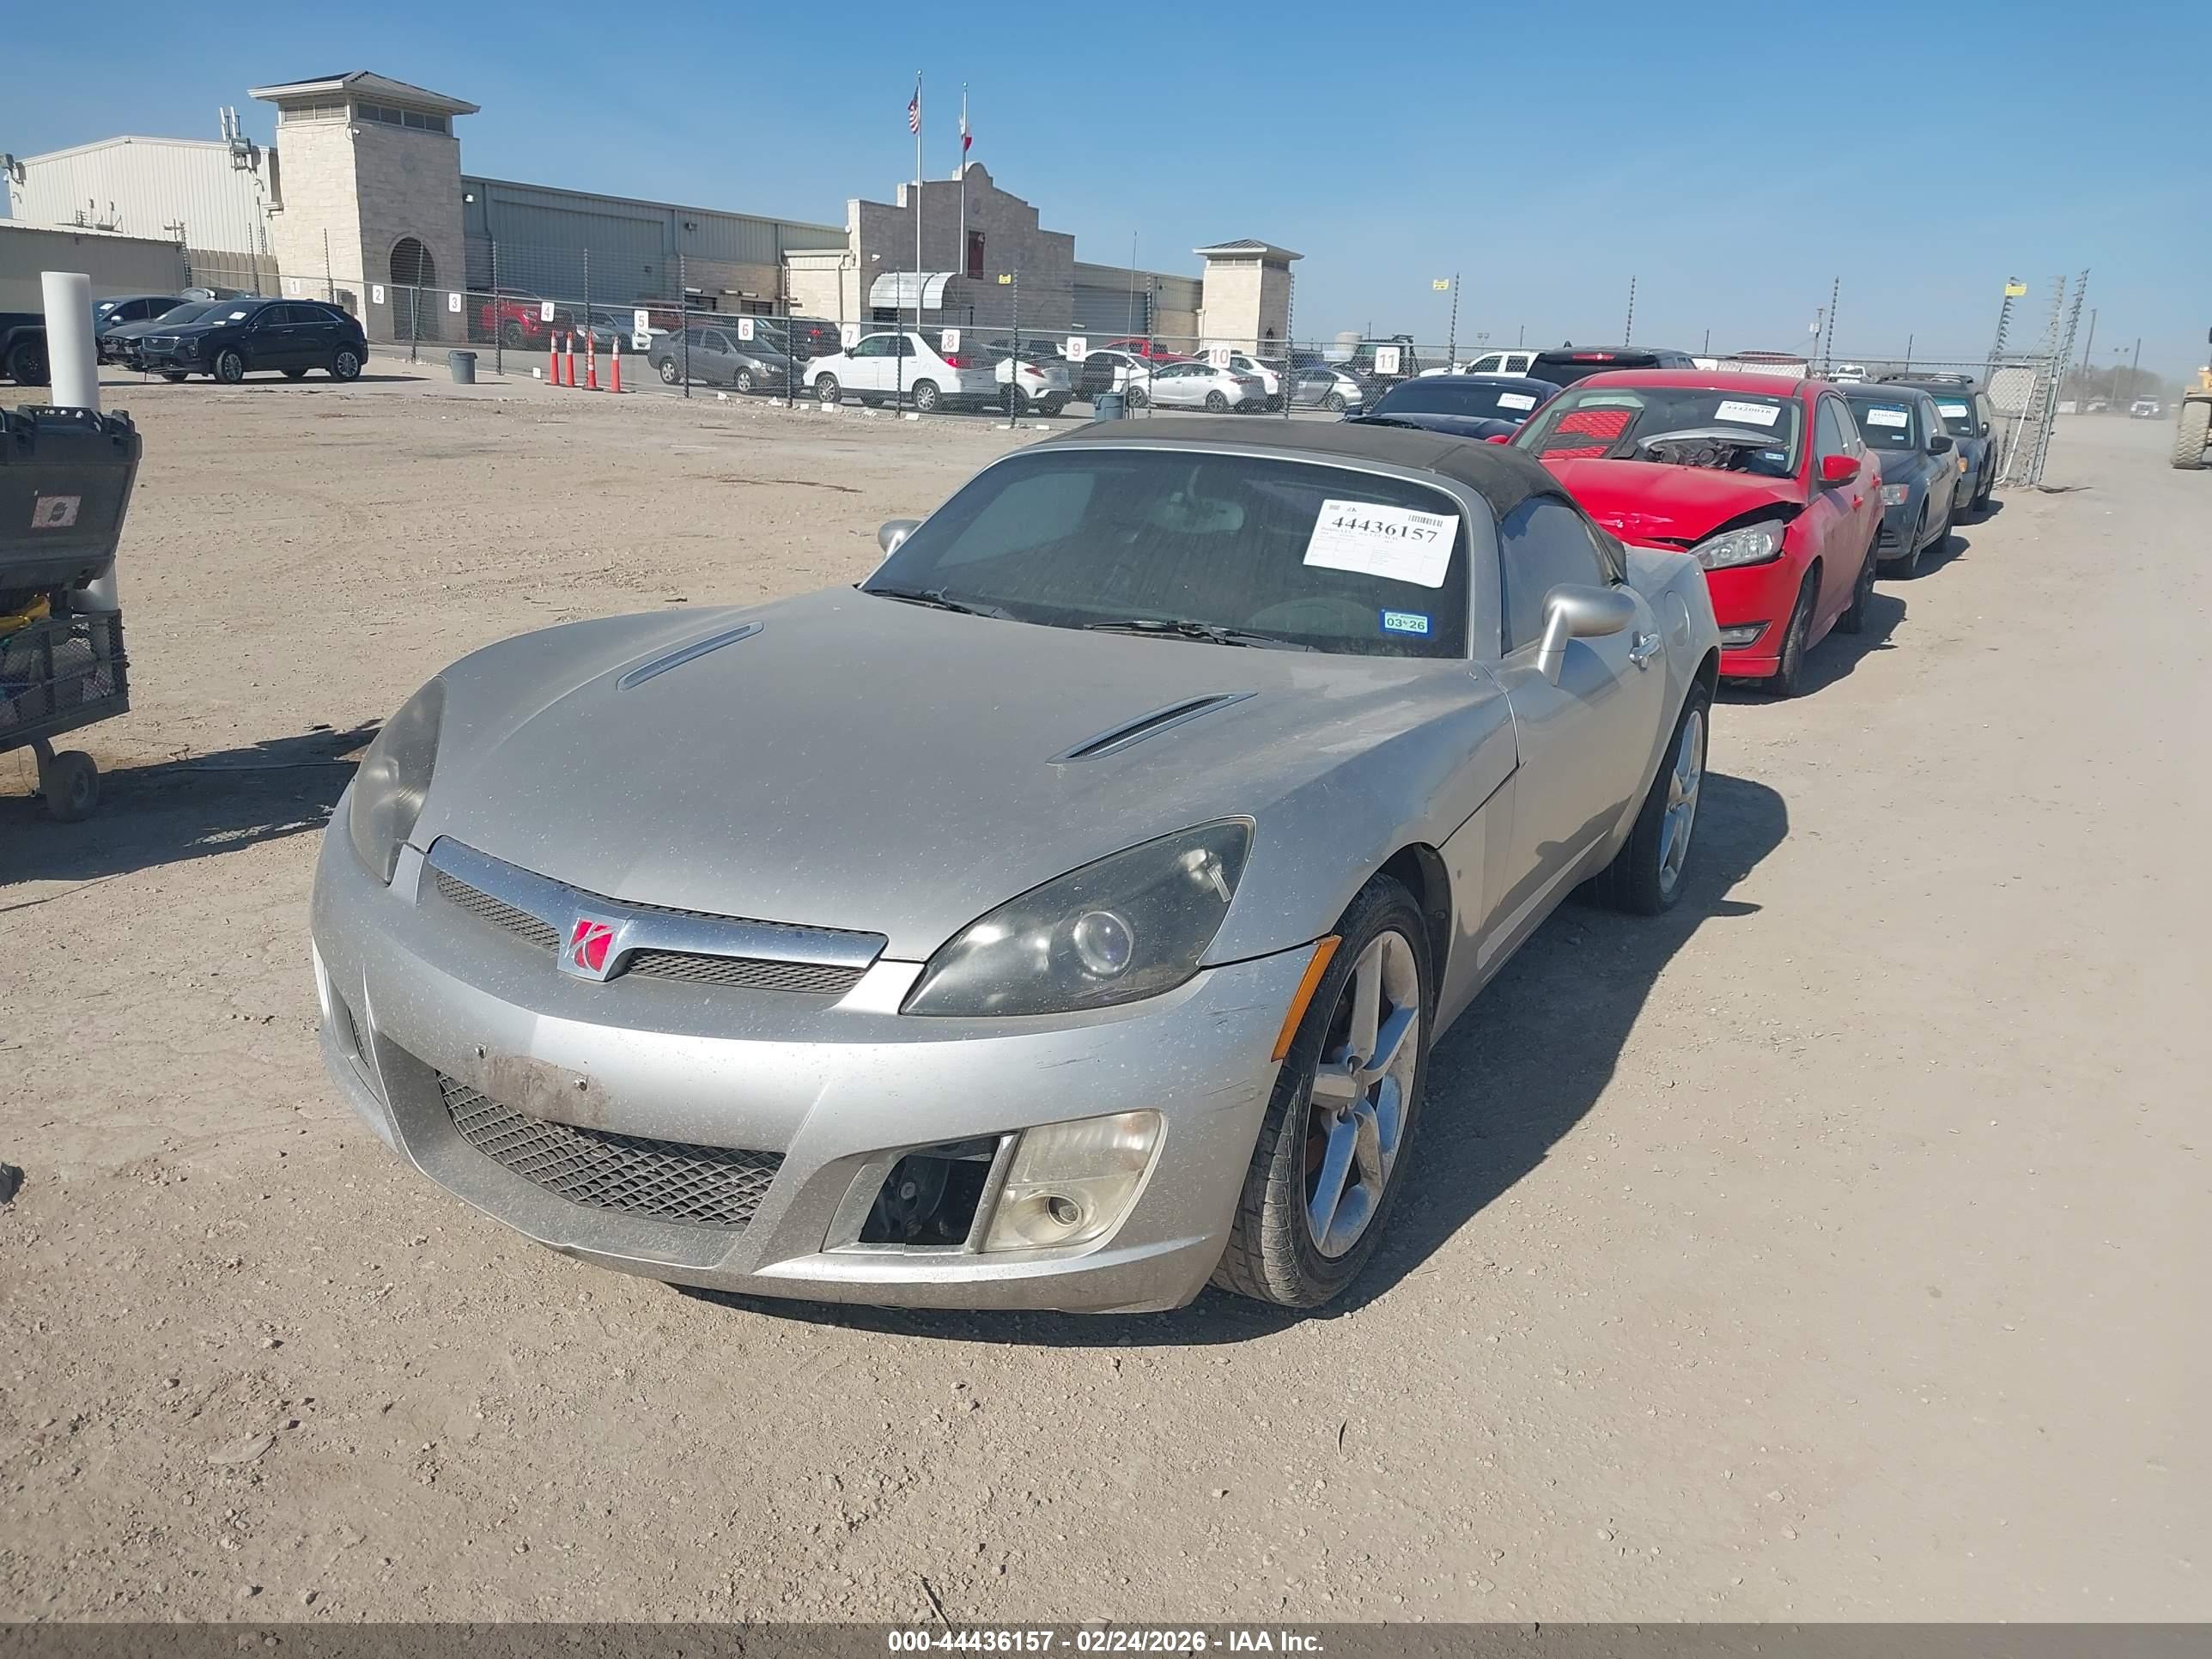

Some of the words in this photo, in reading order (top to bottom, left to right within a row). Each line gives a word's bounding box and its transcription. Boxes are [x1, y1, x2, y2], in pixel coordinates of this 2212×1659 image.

[375, 289, 381, 301] 2
[451, 296, 459, 308] 3
[544, 304, 550, 318] 4
[638, 315, 645, 327] 5
[741, 324, 749, 337] 6
[846, 331, 854, 343] 7
[946, 334, 954, 348] 8
[1072, 343, 1080, 356] 9
[1211, 349, 1229, 364] 10
[1379, 354, 1395, 369] 11
[1332, 516, 1438, 544] 44436157
[1387, 617, 1402, 628] 03
[1409, 620, 1425, 630] 26
